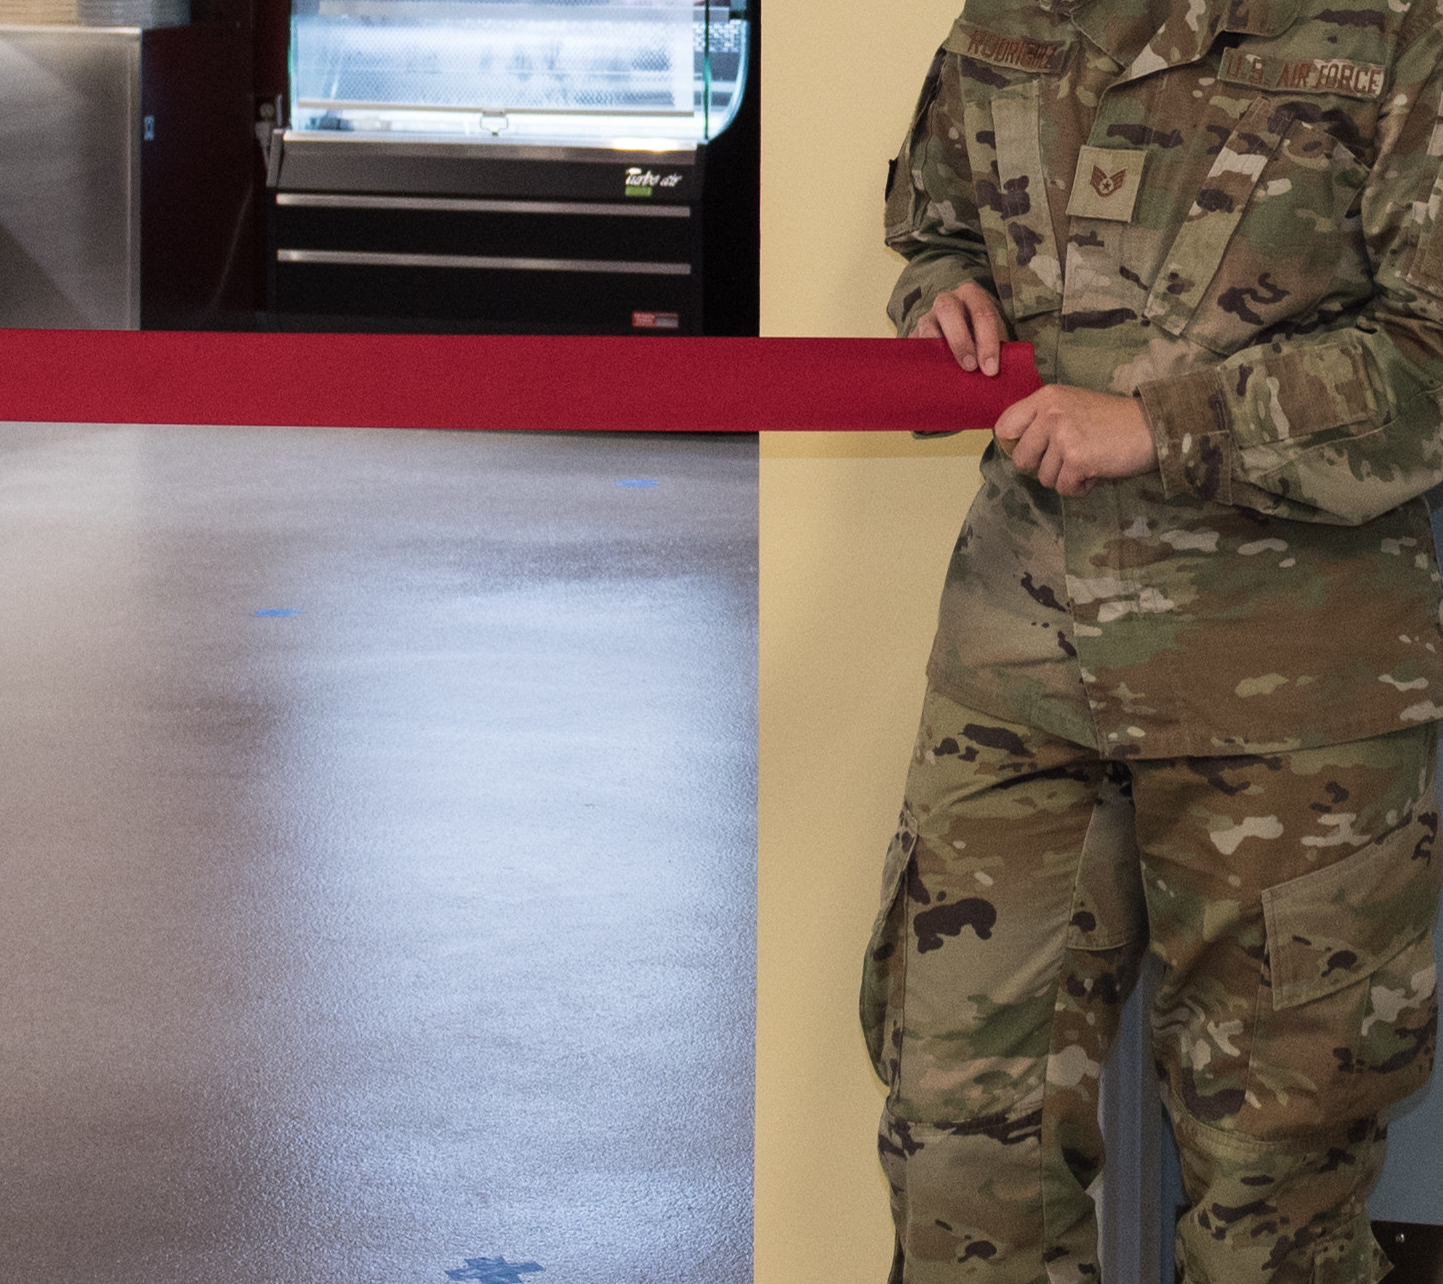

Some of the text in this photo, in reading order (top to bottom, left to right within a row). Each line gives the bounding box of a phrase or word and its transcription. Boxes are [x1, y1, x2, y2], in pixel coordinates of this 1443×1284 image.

[1226, 55, 1382, 94] U.S. AIR FORCE
